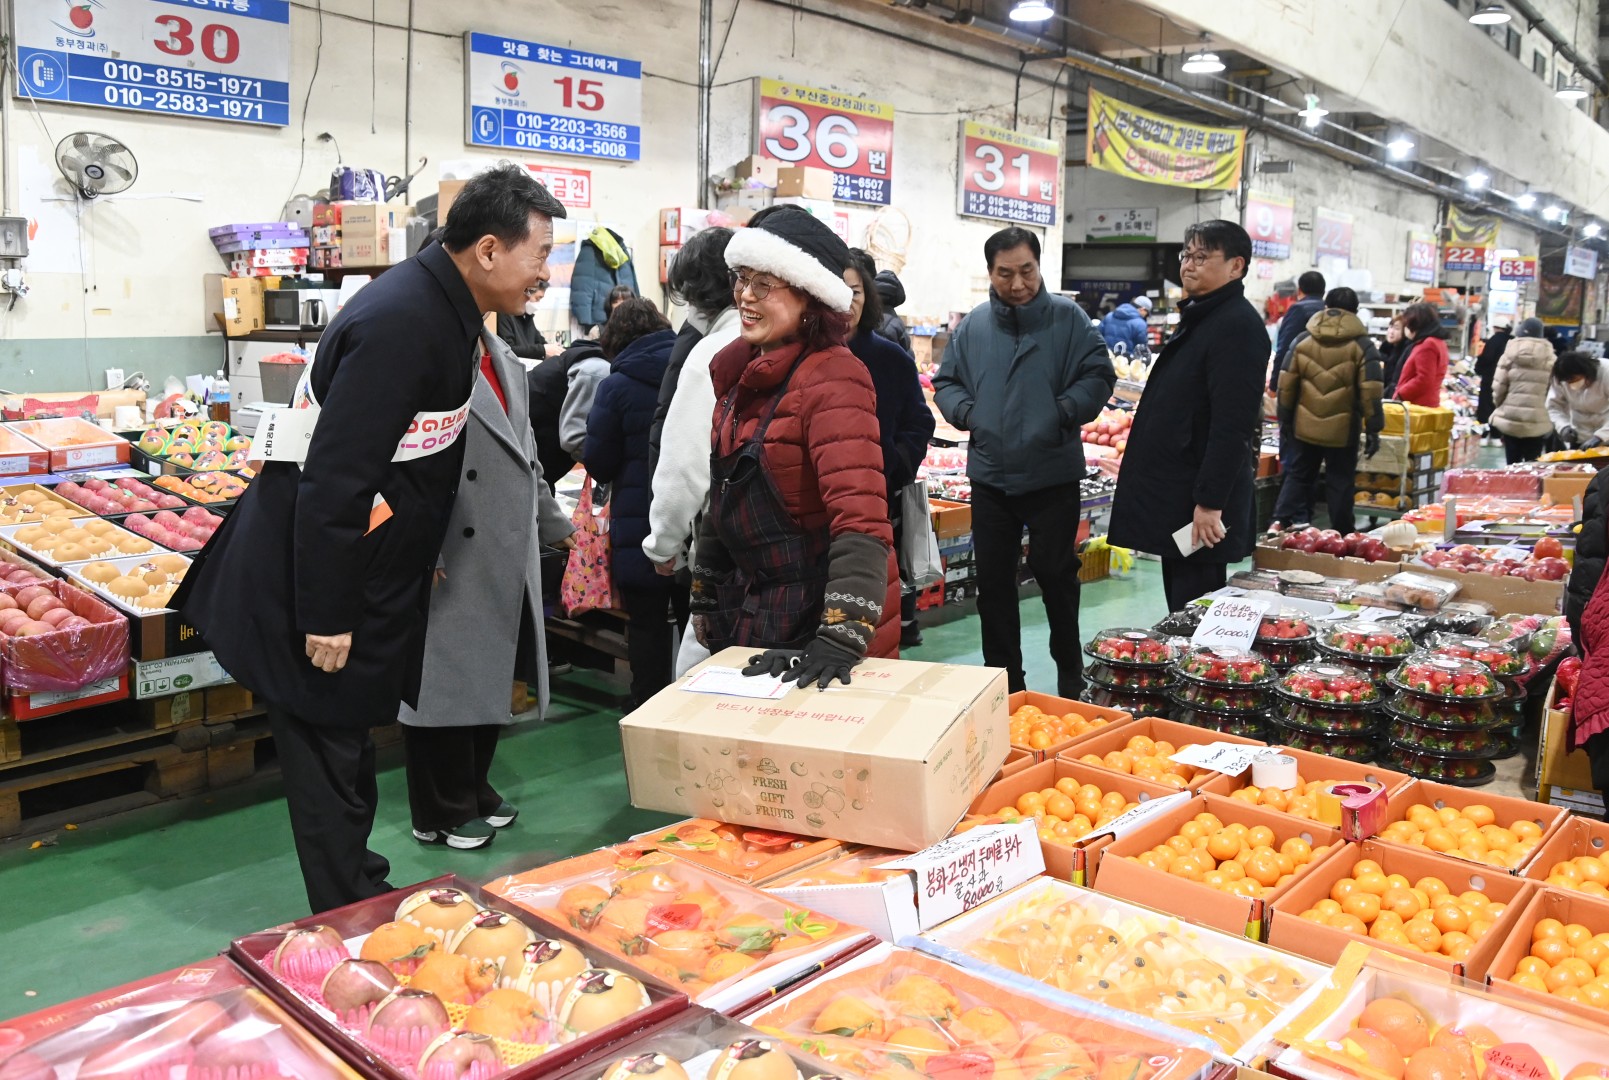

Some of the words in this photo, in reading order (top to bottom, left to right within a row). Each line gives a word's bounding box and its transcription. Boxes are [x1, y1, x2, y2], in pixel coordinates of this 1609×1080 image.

[154, 14, 240, 64] 30
[502, 41, 530, 58] 맛을
[537, 47, 563, 64] 찾는
[569, 54, 619, 73] 그대에게
[104, 61, 263, 98] 010-8515-1971
[553, 76, 605, 111] 15
[104, 85, 264, 120] 010-2583-1971
[795, 88, 882, 116] 부산중앙청과(주)
[516, 112, 628, 140] 010-2203-3566
[765, 104, 860, 169] 36
[868, 151, 886, 175] 번
[515, 130, 627, 158] 010-9343-5008
[972, 144, 1029, 197] 31
[1039, 181, 1053, 201] 번
[553, 177, 585, 199] 금연
[969, 192, 987, 204] H.P
[969, 203, 986, 214] H.P
[1256, 206, 1274, 237] 9
[1317, 220, 1344, 250] 22
[1412, 242, 1429, 269] 63
[1448, 248, 1475, 263] 22
[1502, 261, 1525, 276] 63
[264, 423, 275, 457] 해운대구
[716, 702, 752, 713] 반드시
[757, 706, 807, 719] 냉장보관
[811, 712, 865, 724] 바랍니다.
[752, 775, 788, 790] FRESH
[755, 804, 795, 819] FRUITS
[760, 791, 785, 804] GIFT
